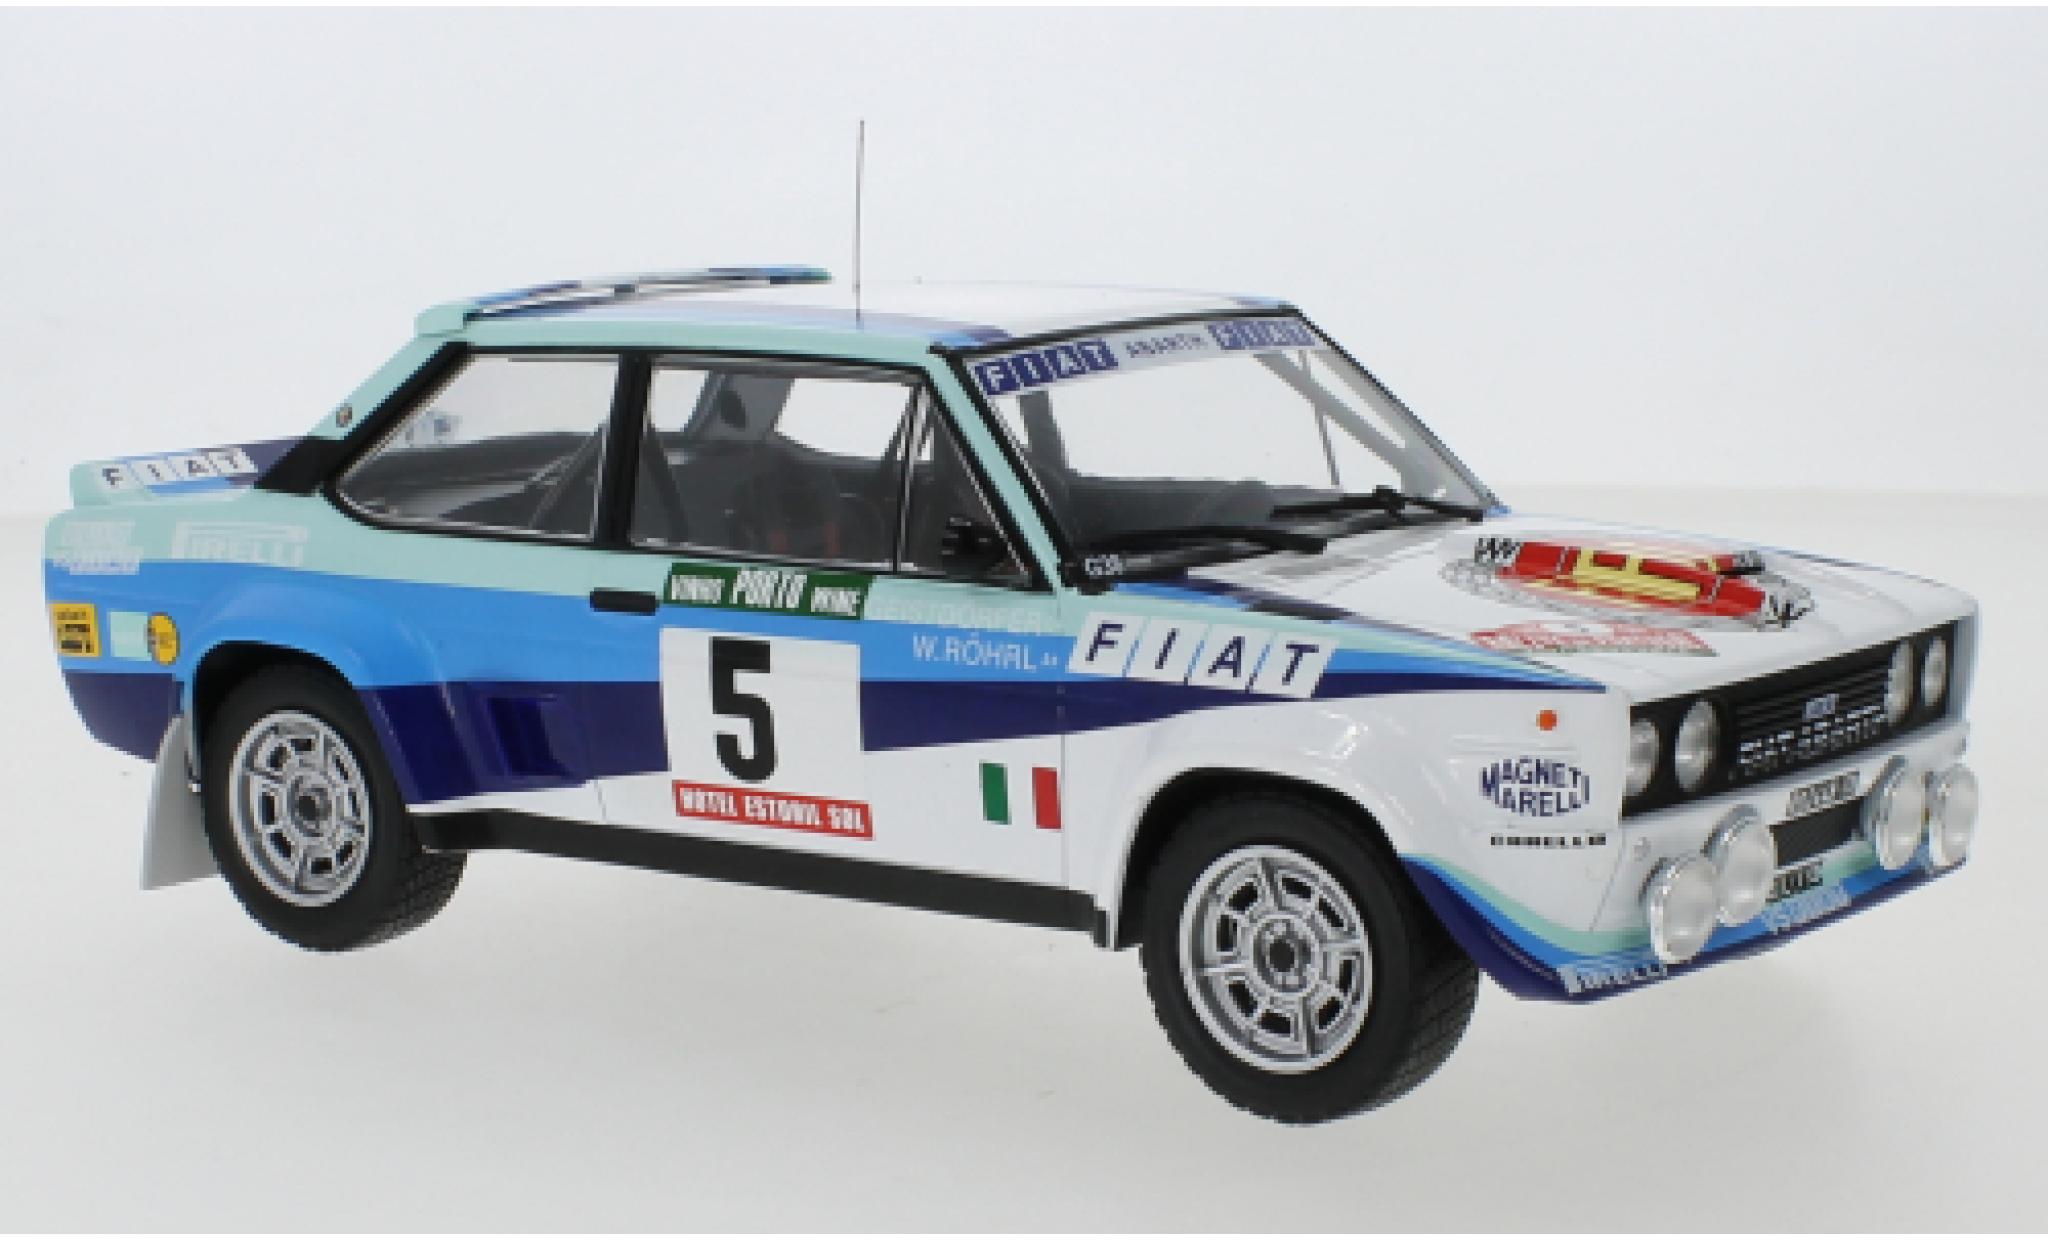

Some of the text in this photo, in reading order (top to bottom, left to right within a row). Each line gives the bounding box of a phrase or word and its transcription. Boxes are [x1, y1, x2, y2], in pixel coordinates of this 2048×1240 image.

[977, 342, 1114, 393] FIAT
[1212, 321, 1314, 349] FIAT
[102, 448, 247, 486] FIAT
[730, 570, 808, 609] PORTO
[1085, 620, 1320, 685] FIAT
[710, 636, 777, 784] 5
